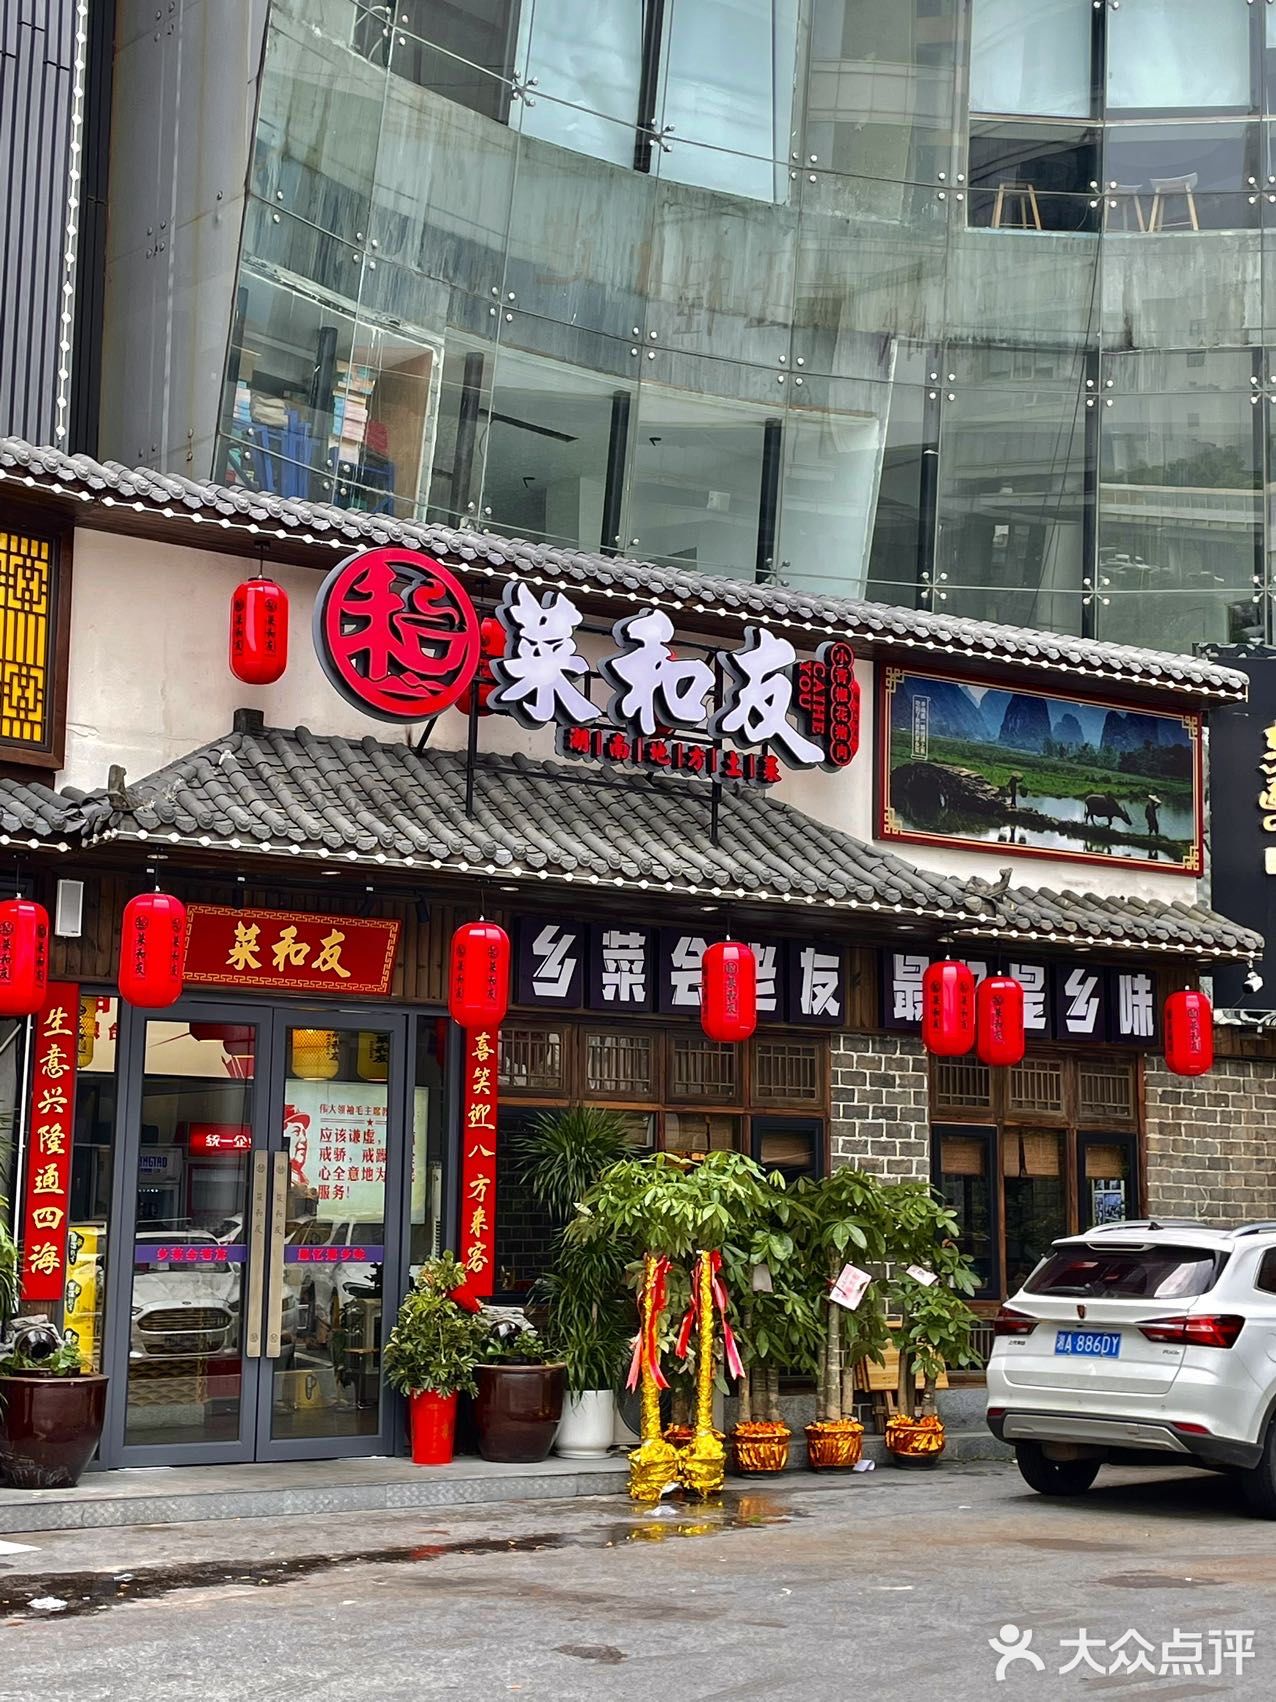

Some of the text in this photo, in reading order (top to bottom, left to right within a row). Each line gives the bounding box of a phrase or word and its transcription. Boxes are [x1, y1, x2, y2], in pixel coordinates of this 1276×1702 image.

[499, 581, 825, 764] 菜和友
[799, 661, 812, 711] YOU
[812, 662, 826, 734] CAIHE
[225, 920, 352, 978] 菜和友
[27, 1006, 73, 1277] 生意兴隆通四海
[205, 1133, 251, 1148] 统一企
[466, 1031, 496, 1274] 喜笑迎八方来客
